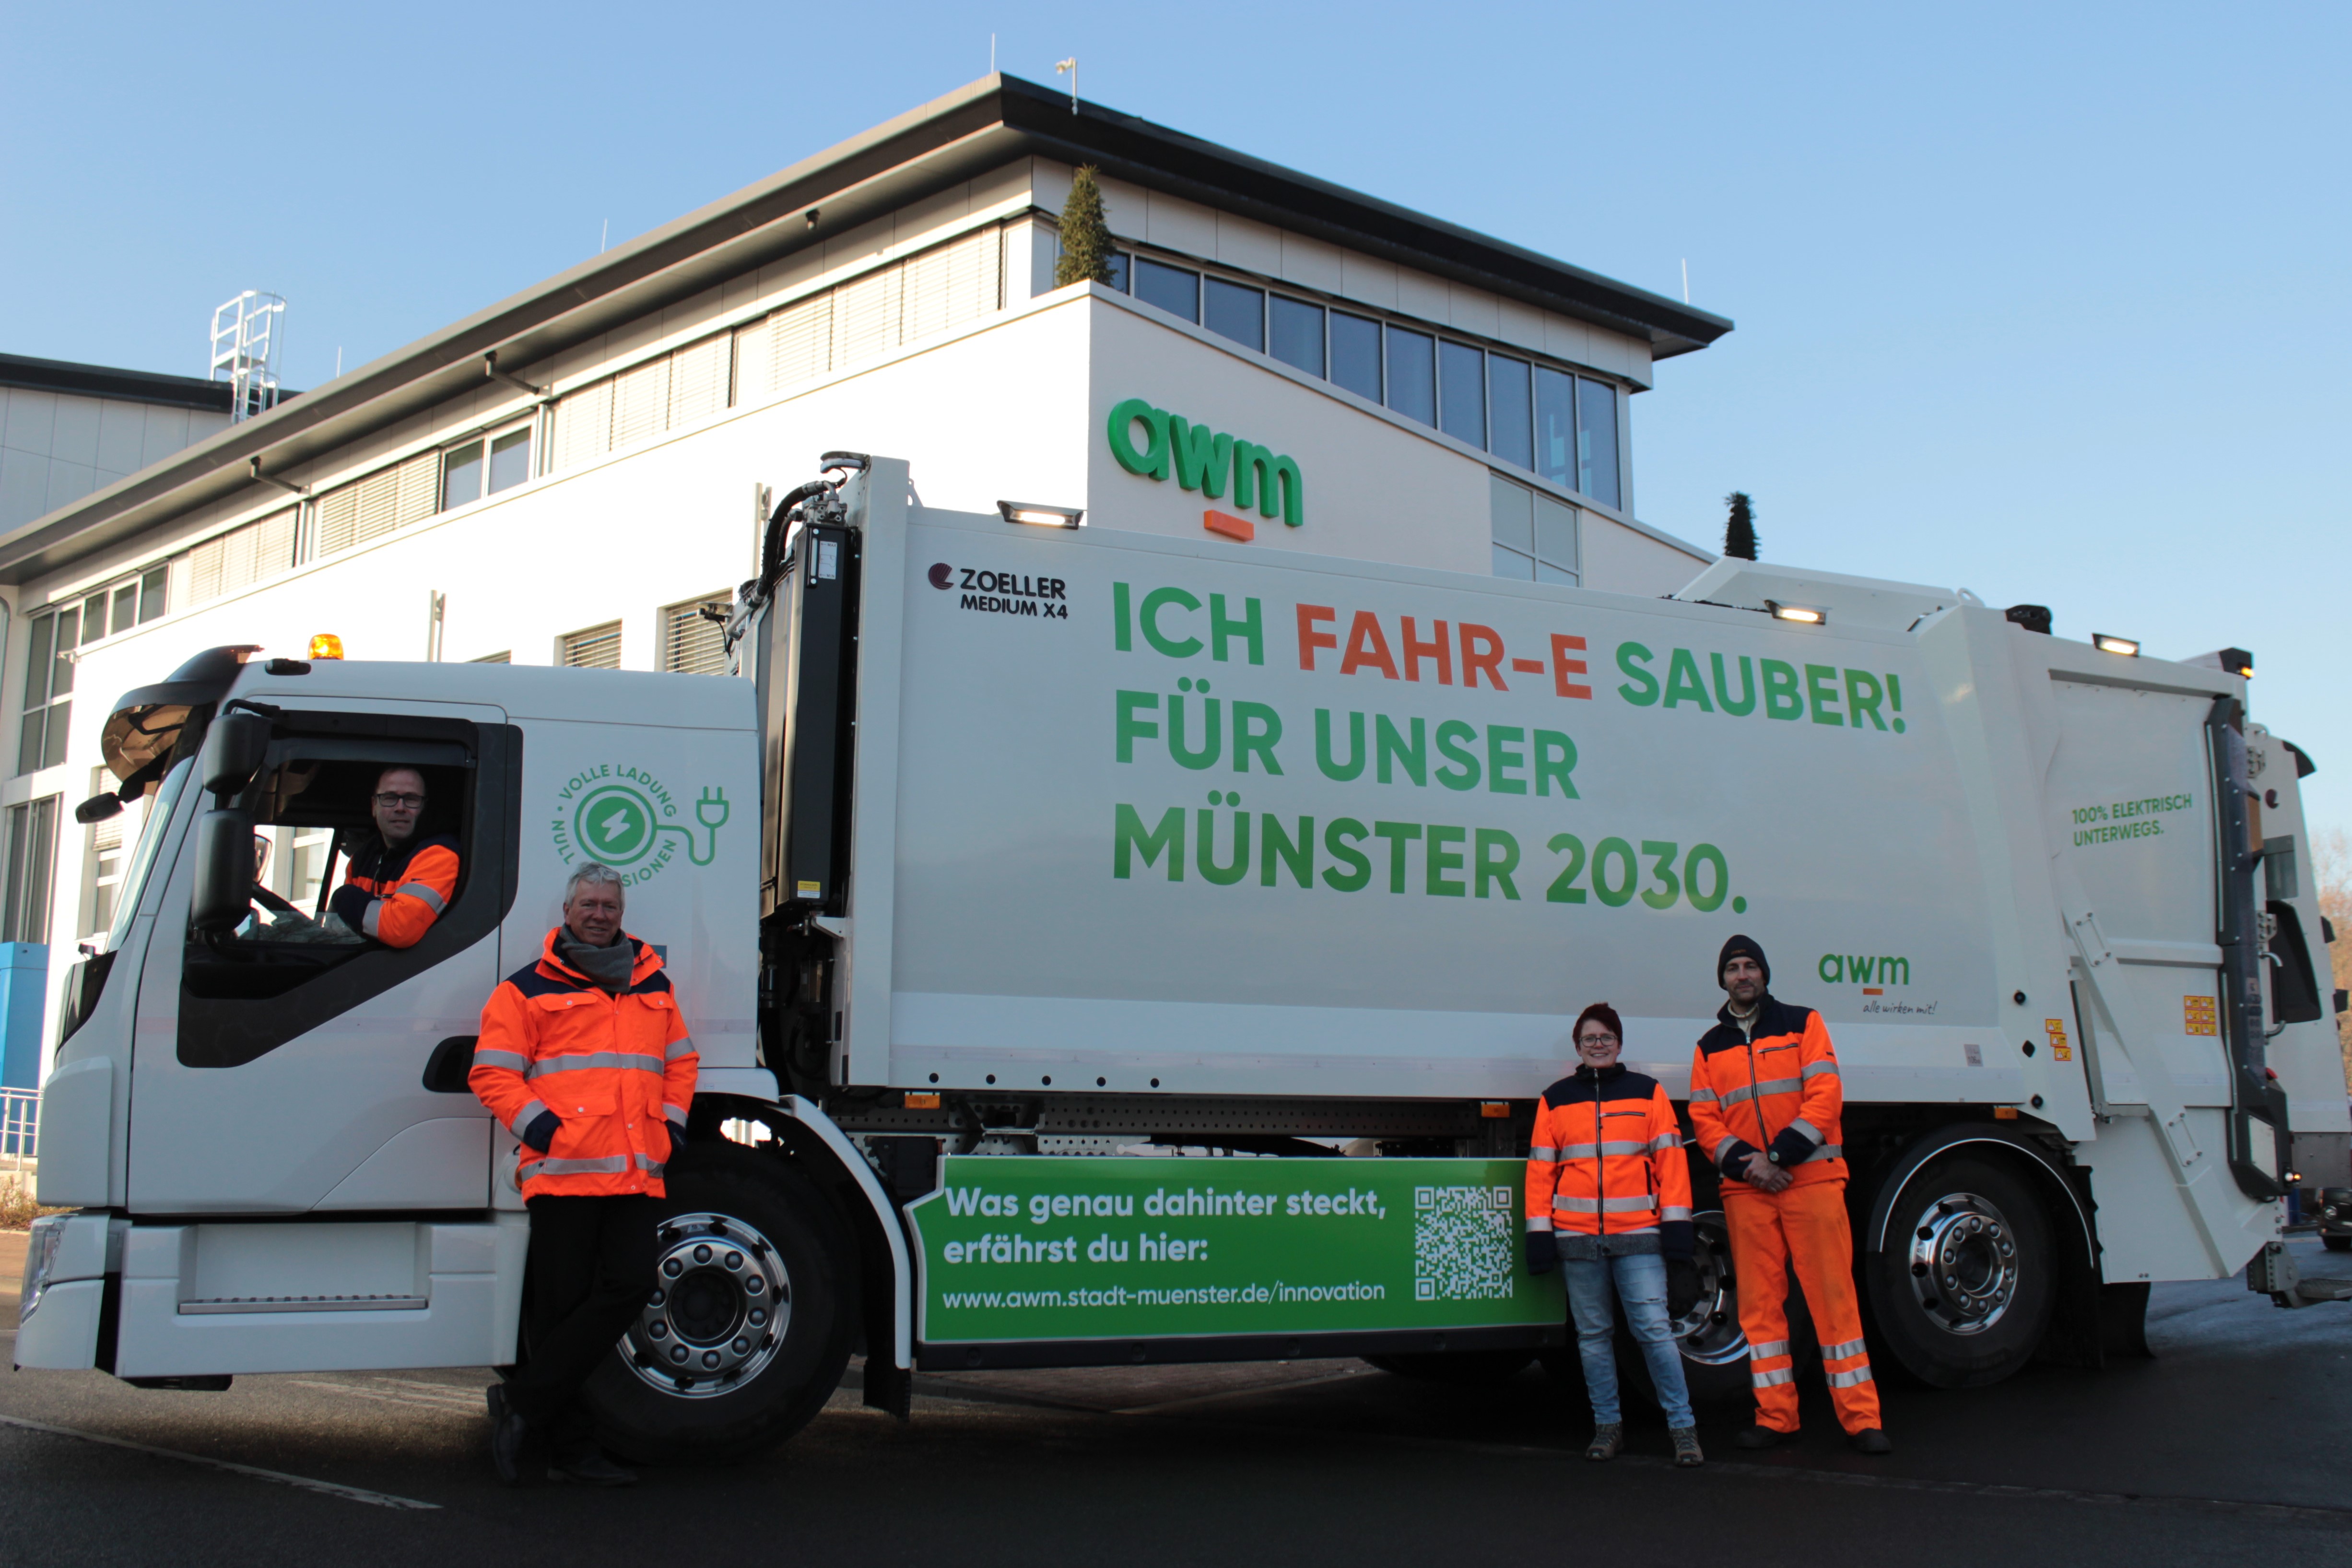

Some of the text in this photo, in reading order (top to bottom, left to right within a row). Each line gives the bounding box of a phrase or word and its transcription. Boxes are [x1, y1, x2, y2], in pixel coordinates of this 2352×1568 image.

[1107, 399, 1304, 527] awm
[960, 568, 1066, 600] ZOELLER
[961, 594, 1068, 620] MEDIUM X4
[1113, 582, 1905, 734] ICH FAHR-E SAUBER!
[1116, 677, 1579, 799] FÜR UNSER
[559, 764, 677, 817] VOLLE LADUNG
[2072, 793, 2192, 825] 100% ELEKTRISCH
[2073, 819, 2164, 847] UNTERWEGS.
[552, 820, 677, 887] NULL SIONEN
[1114, 790, 1747, 914] MÜNSTER 2030.
[1818, 954, 1910, 986] awm
[1863, 1000, 1938, 1015] alle wirken mit!
[944, 1187, 1386, 1225] Was genau dahinter steckt,
[943, 1233, 1208, 1263] erfährst du hier:
[943, 1280, 1385, 1309] www.awm.stadt-muenster.de/innovation
